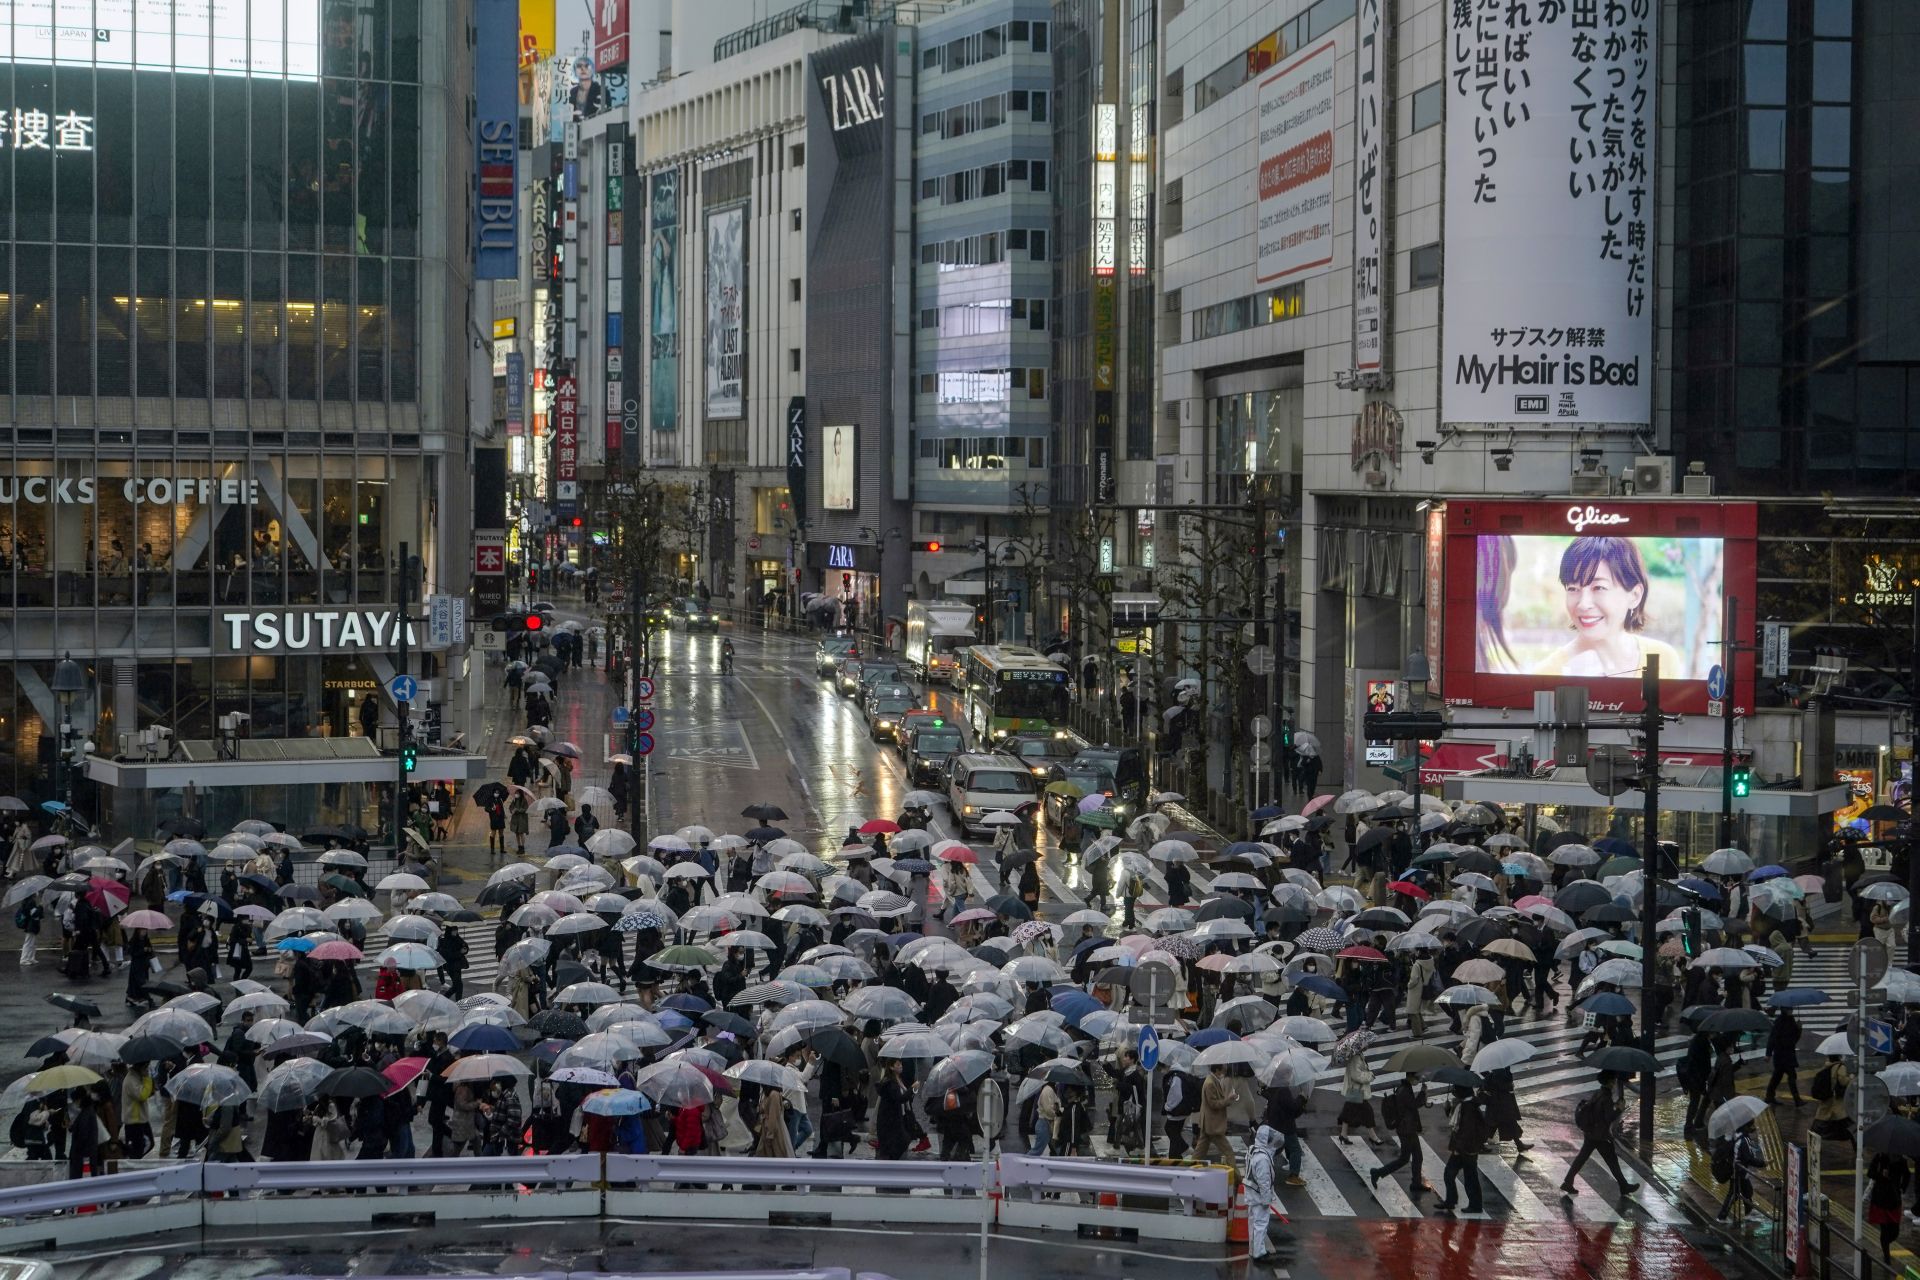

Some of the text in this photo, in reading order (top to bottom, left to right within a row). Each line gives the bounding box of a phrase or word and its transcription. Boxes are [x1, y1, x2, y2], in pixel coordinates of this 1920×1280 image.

[39, 28, 56, 36] LIV
[1503, 0, 1532, 129] ればいい
[822, 62, 885, 131] ZARA
[1569, 0, 1598, 199] 出なくていい
[0, 107, 93, 151] 捜査
[1600, 0, 1627, 260] わかった気がした
[480, 120, 514, 250] SEIBU
[1099, 183, 1113, 215] 内科
[532, 179, 547, 280] KARAOKE
[1098, 221, 1114, 266] 処方せん
[722, 284, 740, 303] ラスト
[720, 303, 742, 327] アイドル
[722, 327, 740, 355] LAST
[1490, 326, 1606, 348] サブスク解禁
[720, 354, 743, 382] ALBUM
[1455, 353, 1639, 394] My Hair is Bad
[1519, 399, 1544, 411] EMI
[560, 400, 576, 477] 東日本銀行
[789, 408, 803, 467] ZARA
[124, 478, 259, 505] COFFEE
[1566, 505, 1630, 533] Glico
[480, 548, 500, 569] 本
[829, 545, 854, 568] ZARA
[1101, 539, 1111, 571] 丸大ビル
[223, 611, 417, 650] TSUTAYA
[438, 598, 449, 643] 渋谷駅前
[454, 599, 463, 642] スクランブル式
[1838, 773, 1863, 783] Disney
